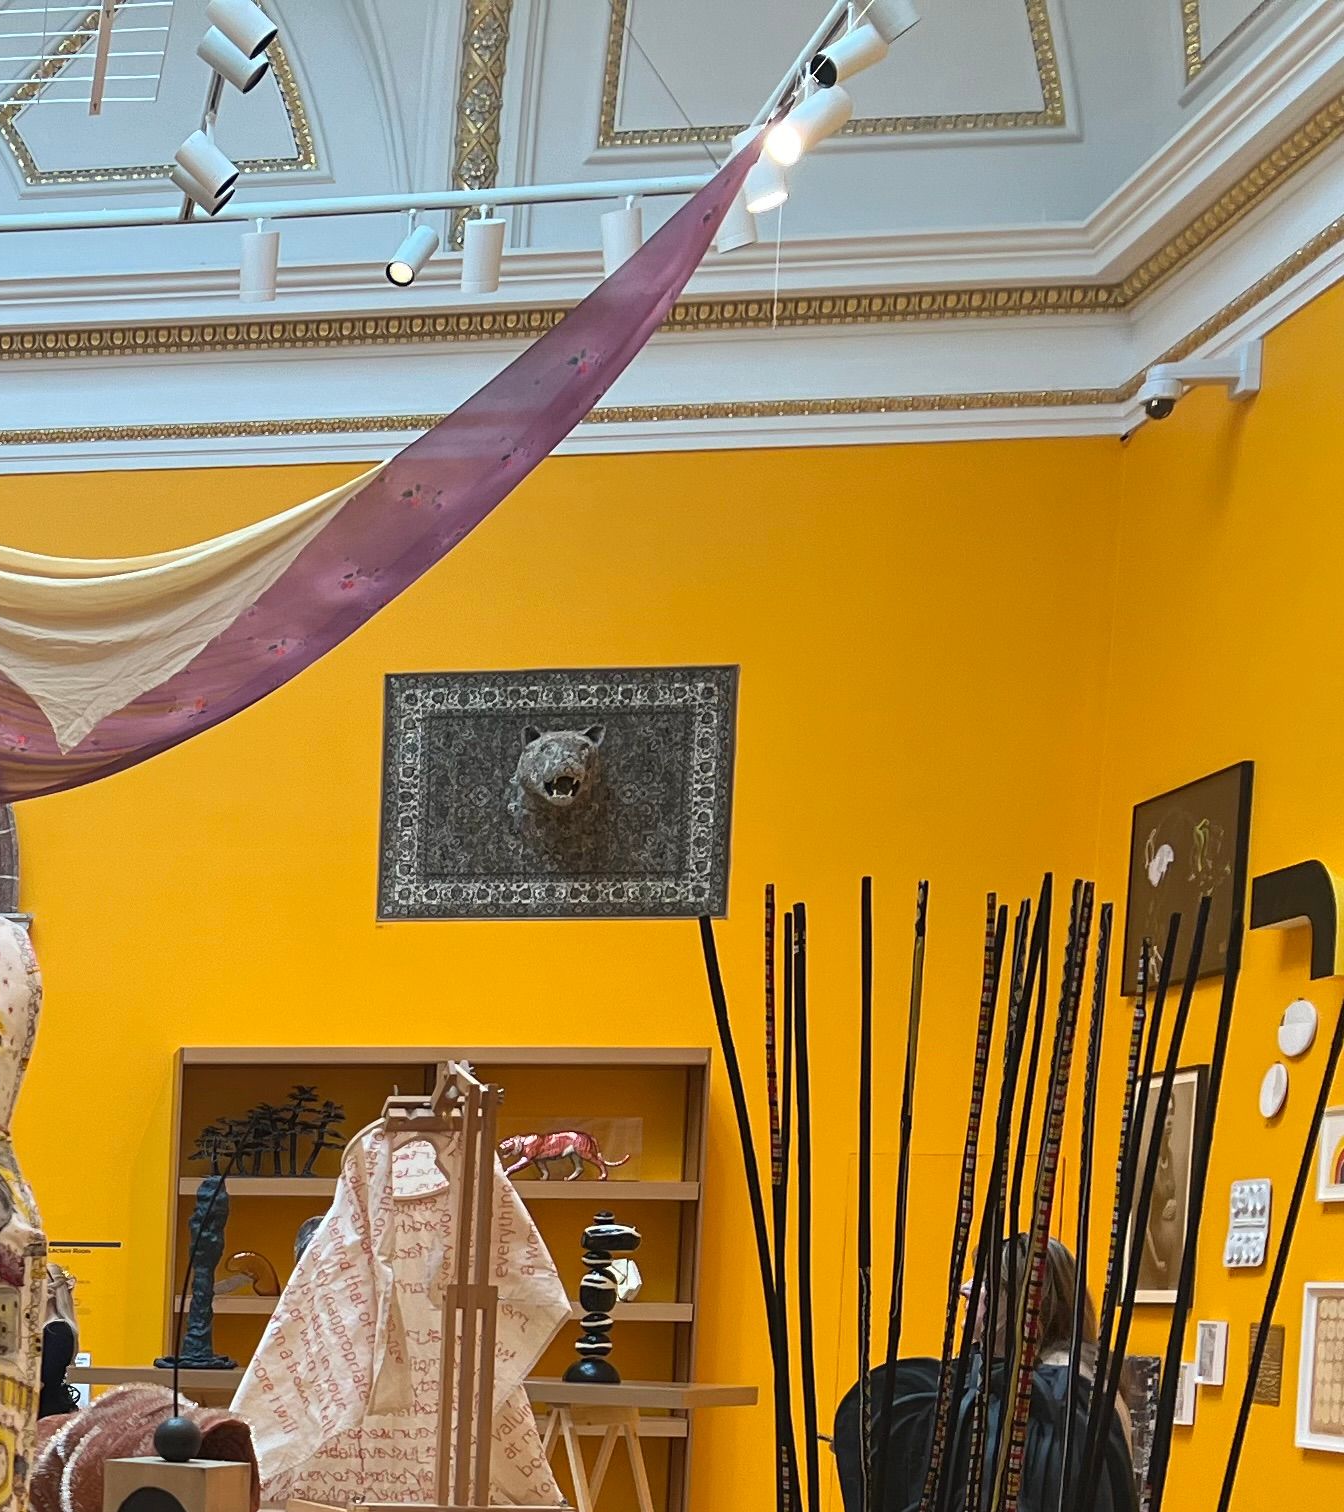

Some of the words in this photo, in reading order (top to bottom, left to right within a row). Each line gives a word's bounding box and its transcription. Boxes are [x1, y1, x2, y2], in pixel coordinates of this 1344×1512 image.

[344, 1275, 368, 1306] that
[321, 1293, 372, 1401] inappropriate
[273, 1404, 299, 1434] will
[491, 1404, 532, 1443] valuin
[515, 1450, 546, 1479] bod
